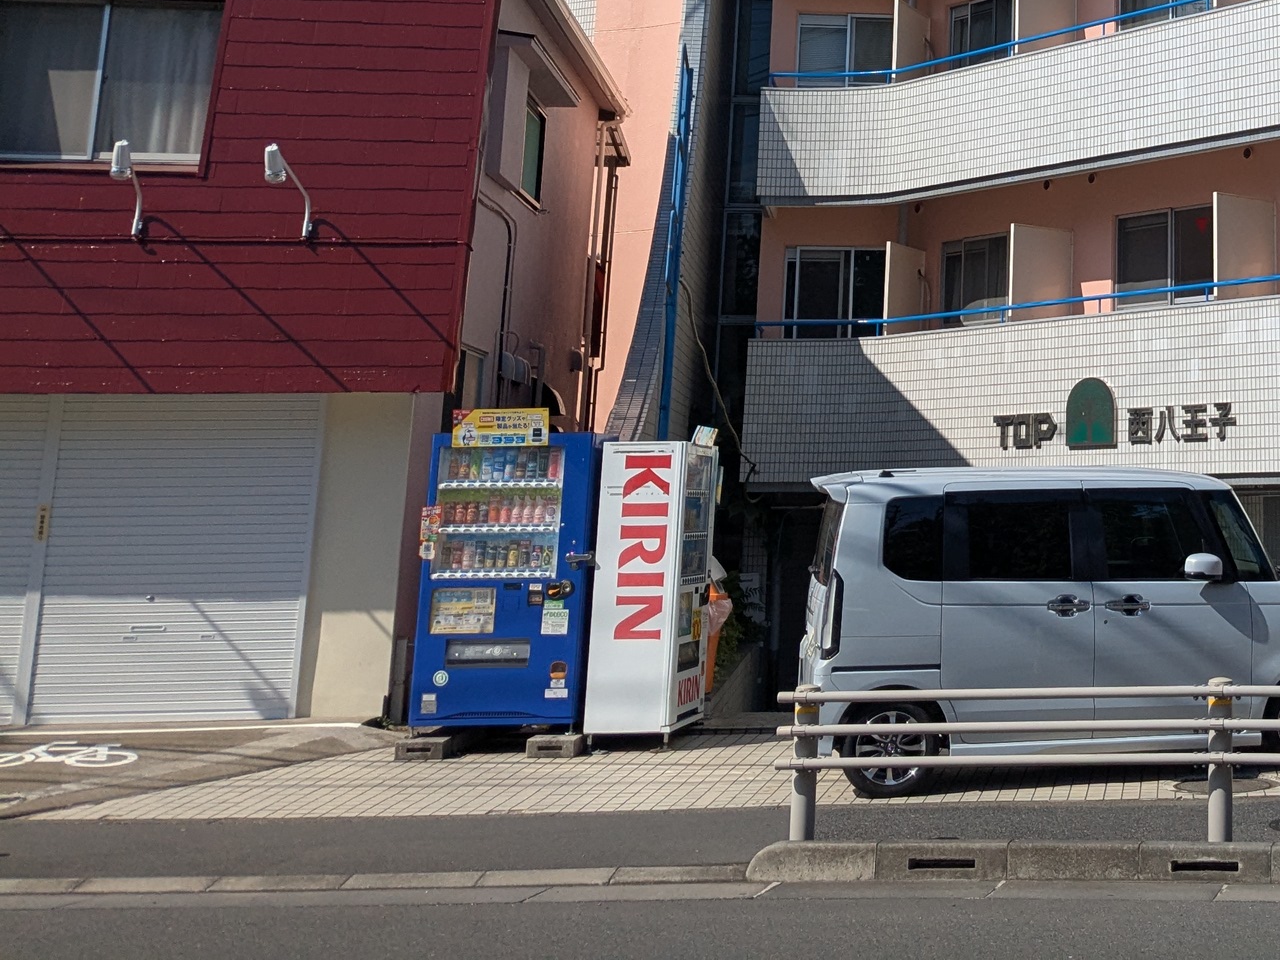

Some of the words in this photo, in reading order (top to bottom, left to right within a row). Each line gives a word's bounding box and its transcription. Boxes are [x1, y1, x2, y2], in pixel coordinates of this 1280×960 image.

[993, 412, 1057, 450] TOP
[1127, 402, 1237, 445] 西八王子
[613, 454, 672, 640] KIRIN
[677, 674, 700, 708] KIRIN
